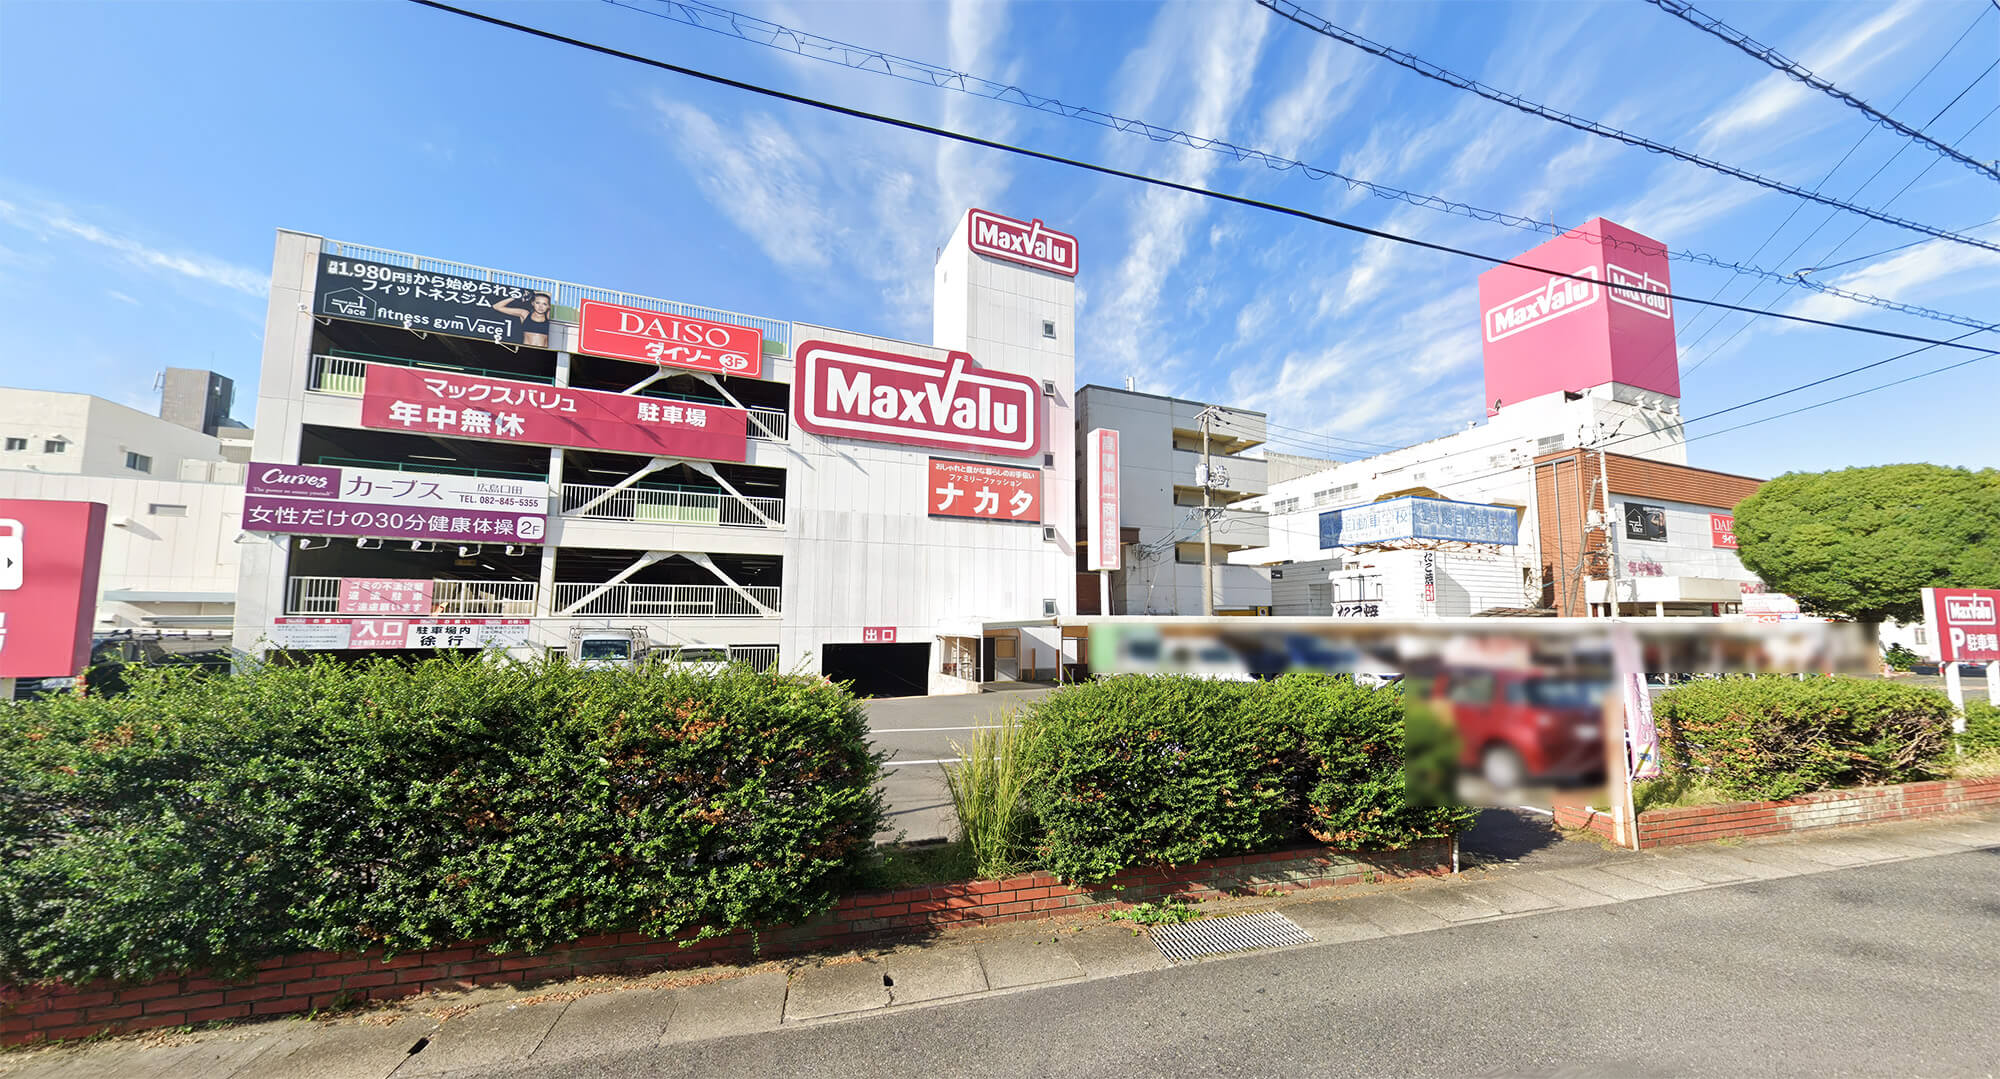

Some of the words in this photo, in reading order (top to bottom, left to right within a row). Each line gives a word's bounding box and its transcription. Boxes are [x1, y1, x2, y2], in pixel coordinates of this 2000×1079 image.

[978, 221, 1066, 263] MaxValu
[362, 279, 491, 307] フィットネスジム
[1613, 272, 1666, 310] MaxValu
[1495, 277, 1589, 333] MaxValu
[377, 307, 429, 327] fitness
[433, 318, 464, 330] gym
[618, 311, 730, 347] DAISO
[645, 342, 711, 362] ダイソー
[723, 355, 744, 367] 3F
[424, 378, 577, 413] マックスバリュ
[826, 358, 1018, 433] MaxValu
[388, 400, 526, 437] 年中無休
[637, 402, 706, 427] 駐車場
[261, 468, 328, 488] Curves
[346, 475, 443, 500] カーブス
[480, 496, 538, 508] 082-845-5355
[935, 482, 1034, 516] ナカタ
[248, 505, 514, 535] 女性だけの30分健康体操
[520, 521, 541, 535] 2F
[356, 621, 403, 638] 入口
[416, 626, 471, 635] 駐車場内
[420, 635, 464, 647] 徐行
[865, 629, 894, 641] 出口
